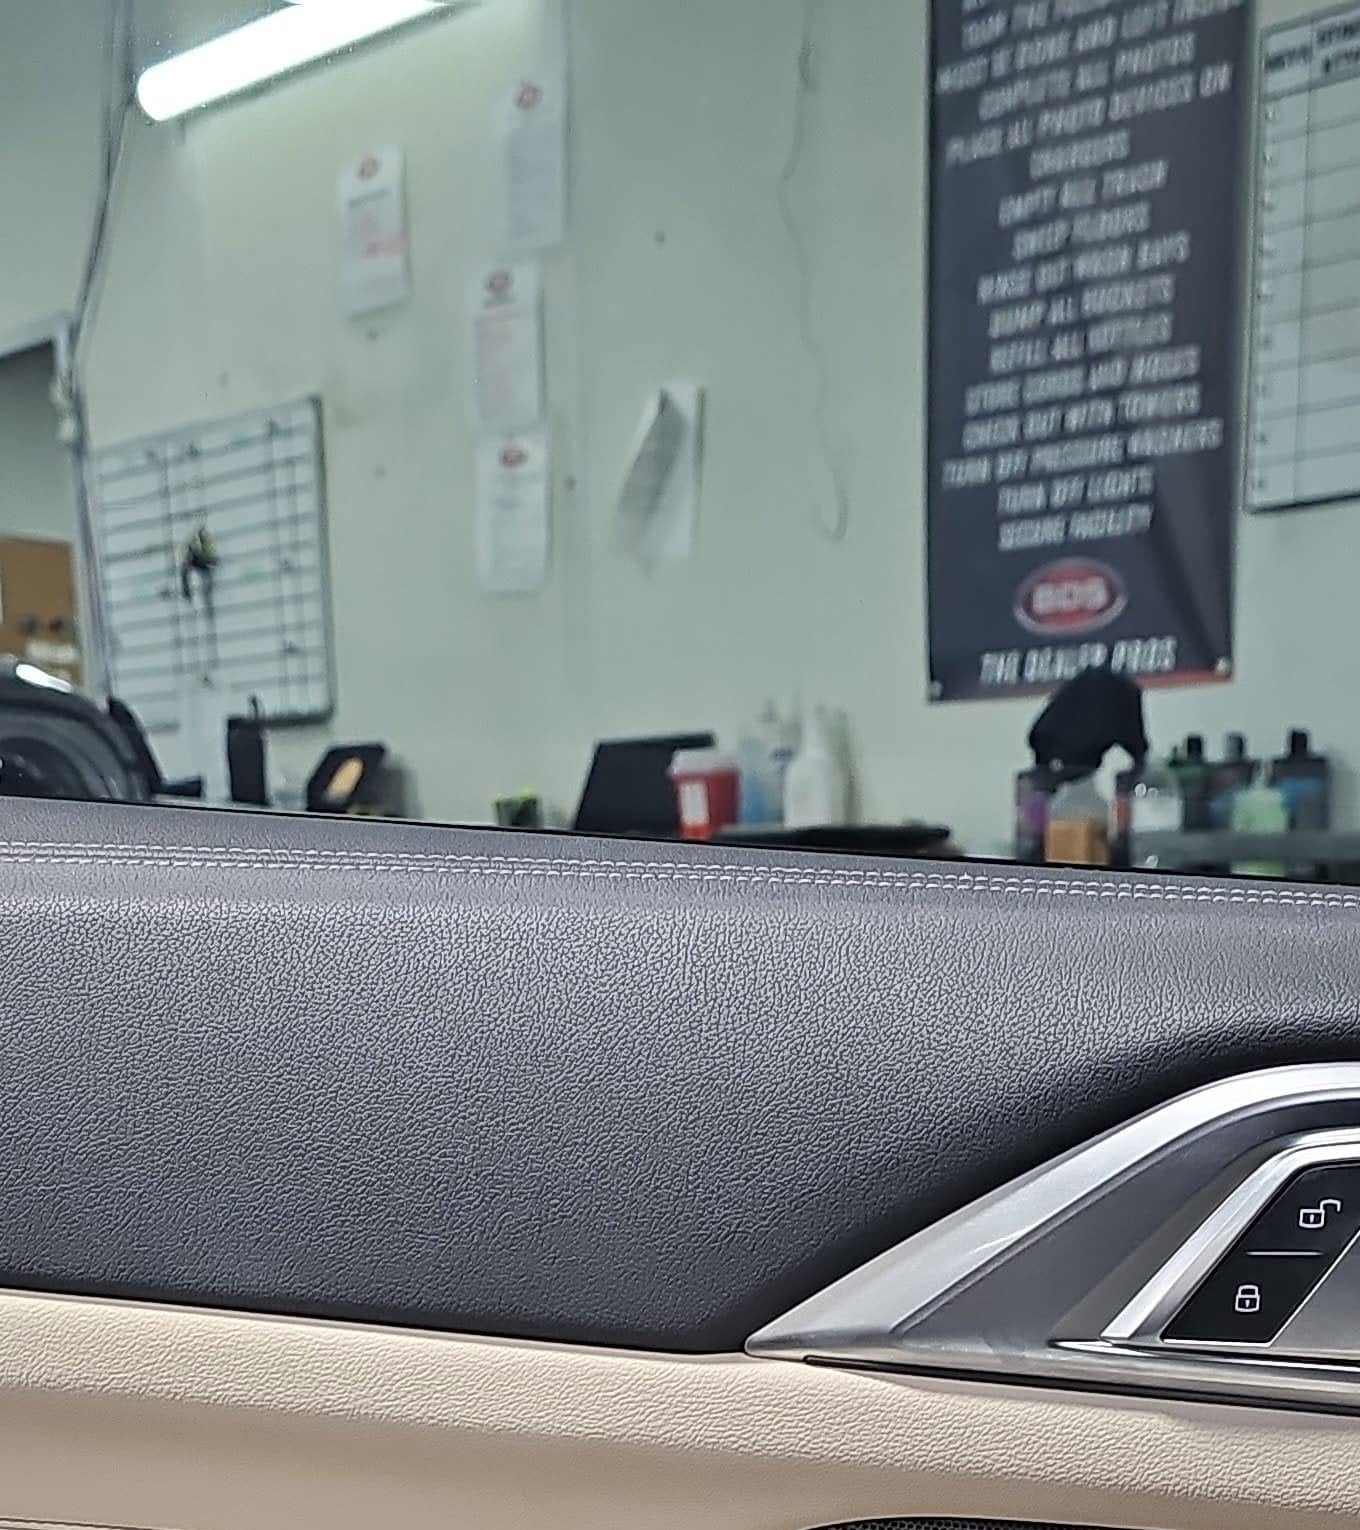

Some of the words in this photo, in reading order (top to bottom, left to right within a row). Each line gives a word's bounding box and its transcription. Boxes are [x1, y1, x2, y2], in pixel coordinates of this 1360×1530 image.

[1114, 32, 1195, 76] PHOTOS
[1037, 99, 1105, 136] PHOTO
[1199, 62, 1231, 97] ON
[1046, 296, 1075, 325] ALL
[1051, 332, 1086, 359] ALL
[980, 652, 1020, 684] THE
[1111, 637, 1178, 673] PROS
